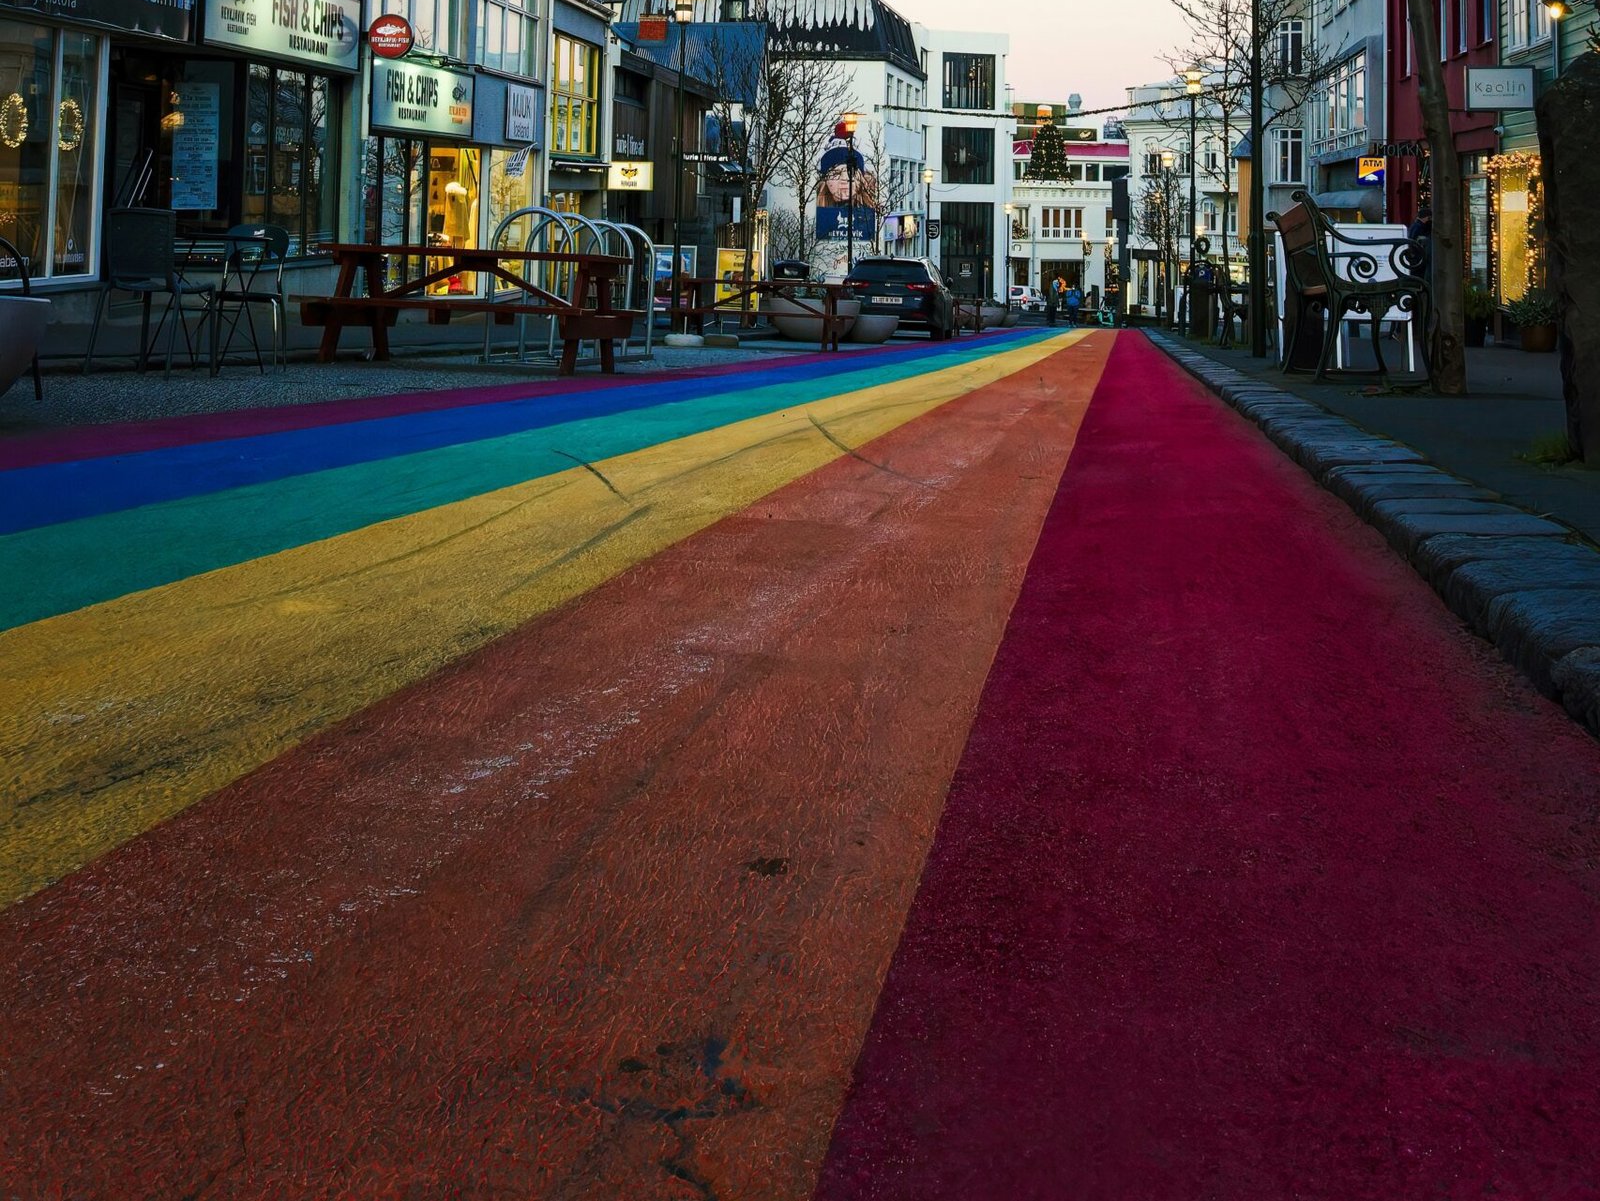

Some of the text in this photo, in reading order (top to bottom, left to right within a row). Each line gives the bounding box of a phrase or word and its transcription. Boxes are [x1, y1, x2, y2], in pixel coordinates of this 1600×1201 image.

[313, 0, 345, 41] CHIPS
[289, 34, 328, 57] RESTAURANT
[386, 68, 439, 108] FISH & CHIPS
[1474, 80, 1526, 93] Kaolin
[398, 107, 427, 123] RESTAURANT
[1362, 159, 1383, 167] ATM
